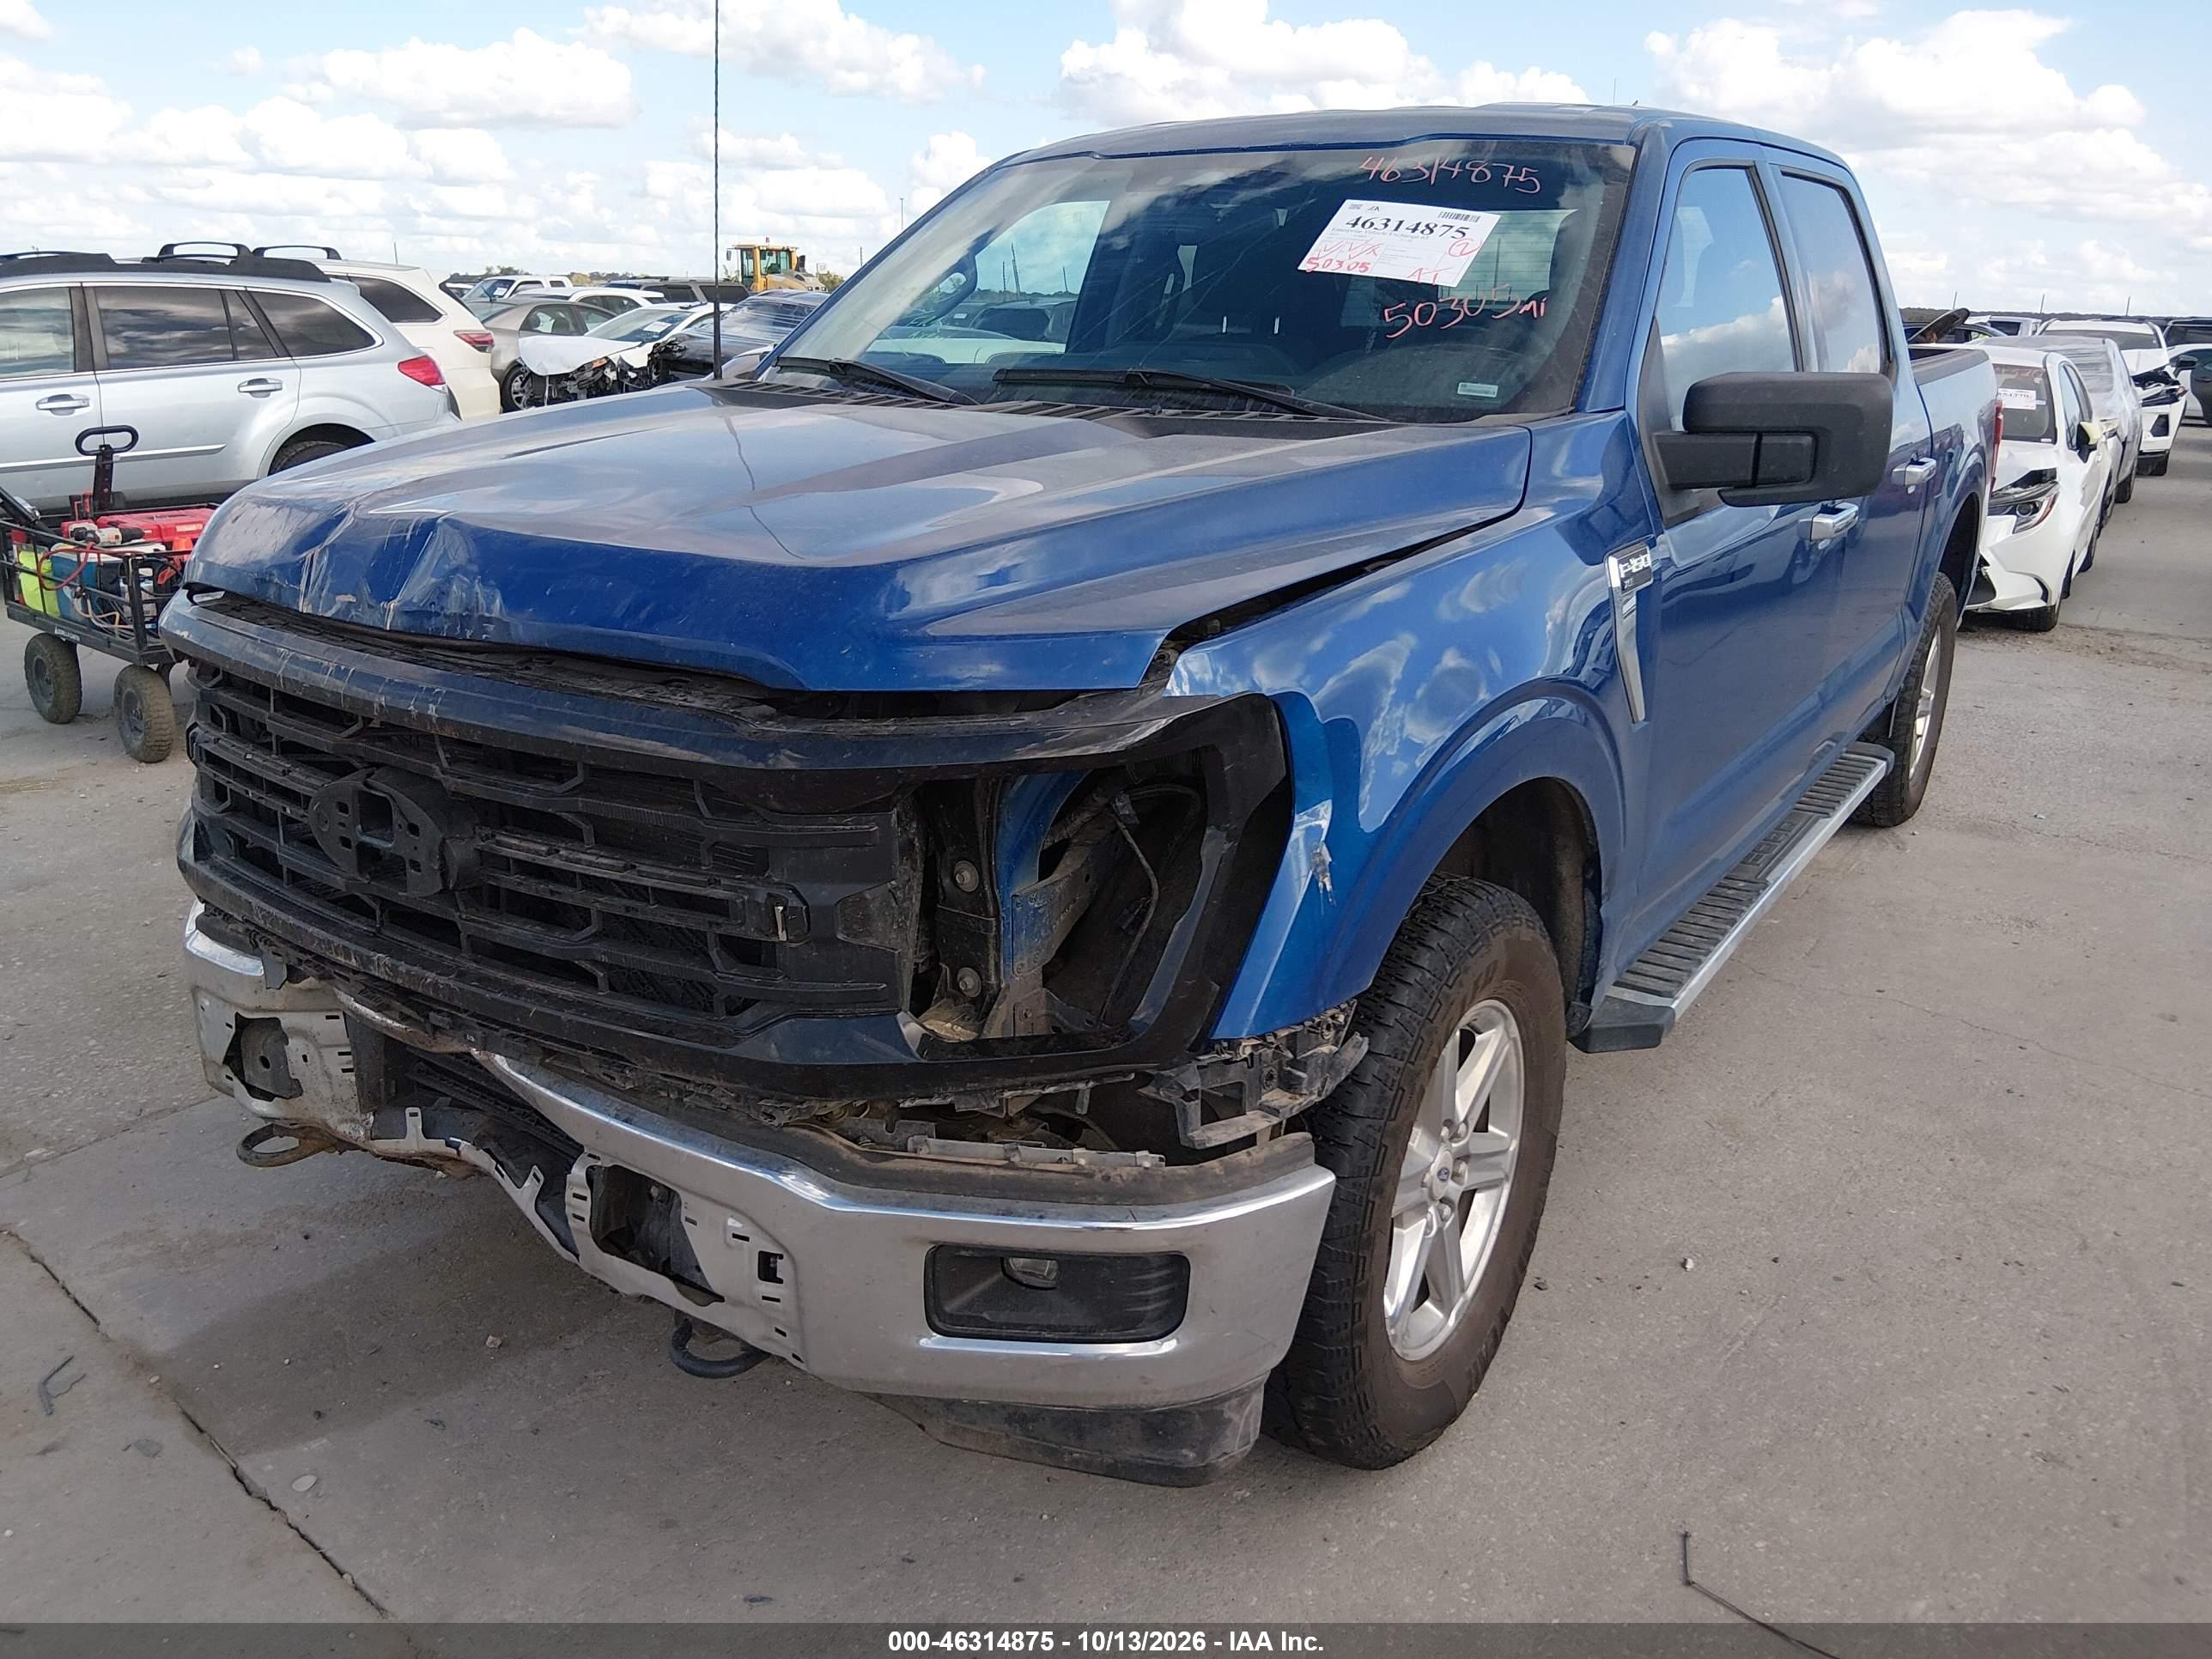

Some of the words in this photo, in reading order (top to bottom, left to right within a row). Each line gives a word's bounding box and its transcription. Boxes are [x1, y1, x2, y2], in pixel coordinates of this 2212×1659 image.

[1358, 155, 1541, 195] 46314875
[1345, 215, 1470, 240] 46314875
[1304, 256, 1371, 273] 50305
